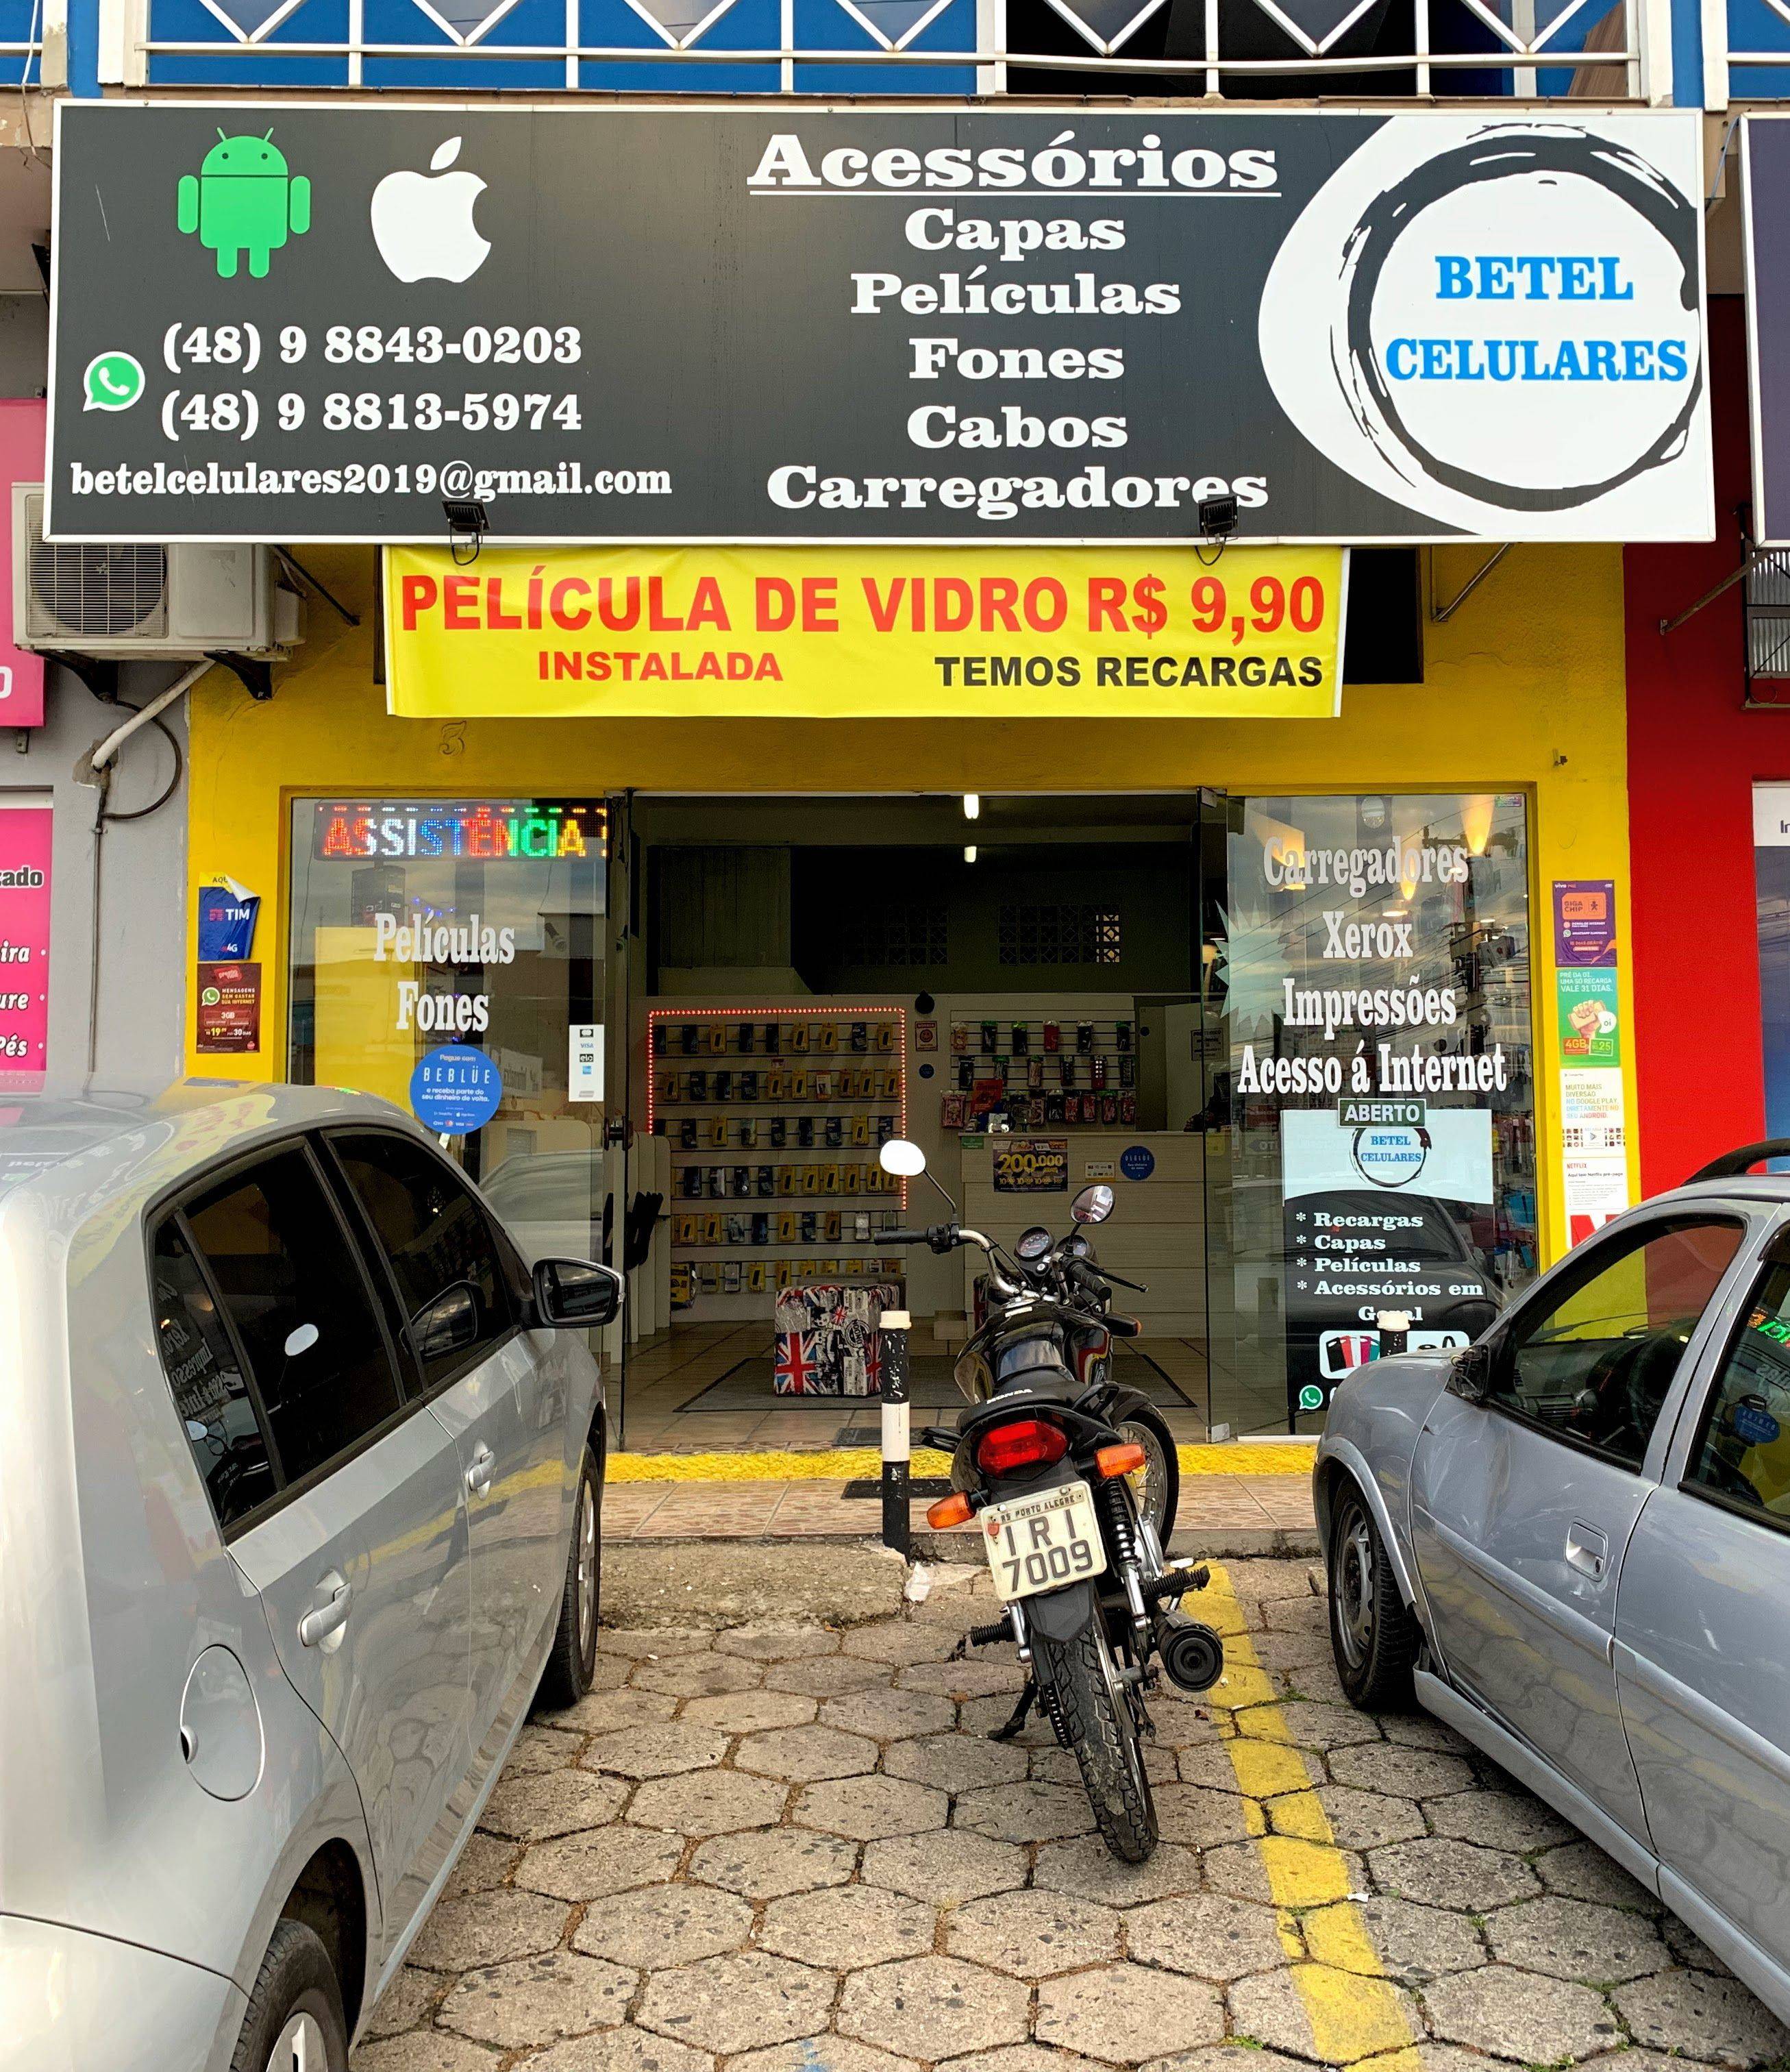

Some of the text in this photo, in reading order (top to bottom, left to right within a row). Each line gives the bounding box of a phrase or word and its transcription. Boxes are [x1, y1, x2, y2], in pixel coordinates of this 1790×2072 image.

[747, 130, 1278, 188] Acessórios
[905, 208, 1126, 261] Capas
[850, 264, 1181, 315] Películas
[1434, 256, 1633, 300] BETEL
[163, 322, 581, 373] (48) 9 8843-0203
[908, 338, 1124, 380] Fones
[1385, 338, 1688, 382] CELULARES
[161, 389, 582, 441] (48) 9 8813-5974
[907, 405, 1128, 449] Cabos
[71, 460, 672, 503] betelcelulares2019@gmail.com
[767, 465, 1269, 520] Carregadores
[401, 565, 1324, 646] PELÍCULA DE VIDRO R$ 9,90
[538, 651, 784, 681] INSTALADA
[934, 656, 1323, 687] TEMOS RECARGAS
[323, 811, 588, 857] ASSISTÊNCIA
[0, 867, 43, 887] ado
[1263, 836, 1468, 898] Carregadores
[225, 908, 251, 921] TIM
[1322, 911, 1413, 959] Xerox
[373, 910, 515, 965] Películas
[396, 981, 489, 1032] Fones
[1282, 973, 1456, 1041] Impressões
[1237, 1039, 1507, 1094] Acesso á Internet
[1565, 1039, 1587, 1049] 4GB
[1599, 1041, 1611, 1051] 25
[423, 1065, 490, 1084] BEBLÜE
[1343, 1105, 1420, 1122] ABERTO
[1360, 1151, 1422, 1163] CELULARES
[1370, 1136, 1411, 1146] BETEL
[1313, 1212, 1424, 1231] Recargas
[1314, 1235, 1386, 1253] Capas
[1314, 1257, 1421, 1274] Películas
[1314, 1279, 1483, 1296] Acessórios em
[1358, 1306, 1423, 1321] Gal
[986, 1389, 1033, 1405] HONDA
[1001, 1495, 1075, 1522] RS PORTO ALEGRE
[1002, 1539, 1093, 1592] 7009
